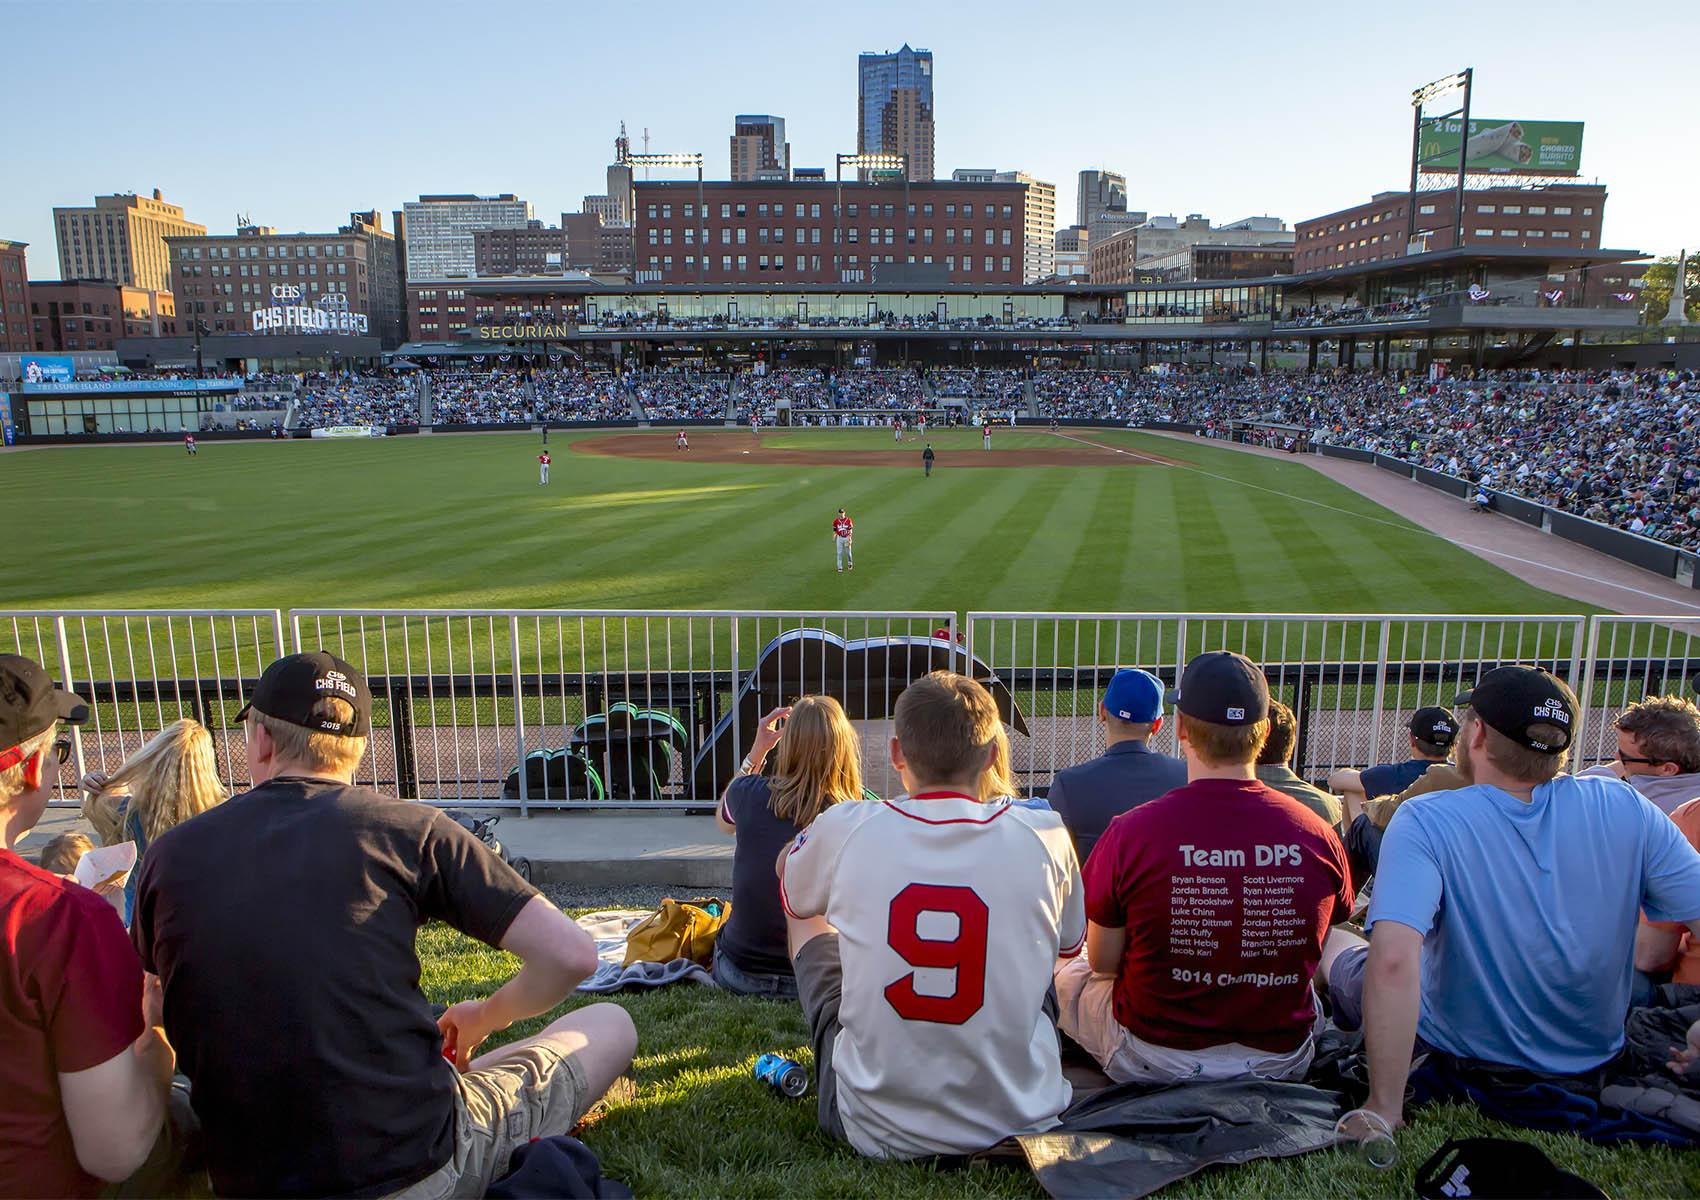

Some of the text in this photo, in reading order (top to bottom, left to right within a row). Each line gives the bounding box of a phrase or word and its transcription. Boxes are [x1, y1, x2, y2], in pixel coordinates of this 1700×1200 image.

[1434, 120, 1442, 132] 2
[272, 286, 300, 298] CHS
[253, 307, 283, 331] CHS
[286, 306, 327, 330] FIELD
[480, 325, 567, 338] SECURIAN
[37, 383, 79, 391] TREASURE
[81, 382, 111, 390] ISLAND
[316, 679, 356, 697] CHS FIELD
[1534, 706, 1569, 724] CHS FIELD
[321, 721, 340, 730] 2015
[1531, 741, 1548, 750] 2015
[1178, 844, 1302, 867] Team DPS
[1171, 876, 1225, 885] Bryan Benson
[1243, 876, 1304, 884] Scott Livermore
[1243, 887, 1262, 896] Ryan
[1171, 897, 1233, 906] Billy Brookshaw
[1243, 897, 1292, 906] Ryan Minder
[1171, 907, 1215, 916] Luke Chinn
[1243, 908, 1269, 916] Tanner
[1170, 918, 1200, 927] Johnny
[1242, 918, 1306, 927] Jordan Petschke
[1191, 929, 1212, 938] Duffy
[1242, 929, 1269, 937] Steven
[1170, 937, 1219, 949] Rhett Hebig
[1241, 937, 1307, 948] Brandon Schmahl
[884, 882, 989, 1025] 9
[1170, 947, 1194, 956] Jacob
[1263, 948, 1278, 956] Turk
[1172, 968, 1299, 987] 2014 Champions
